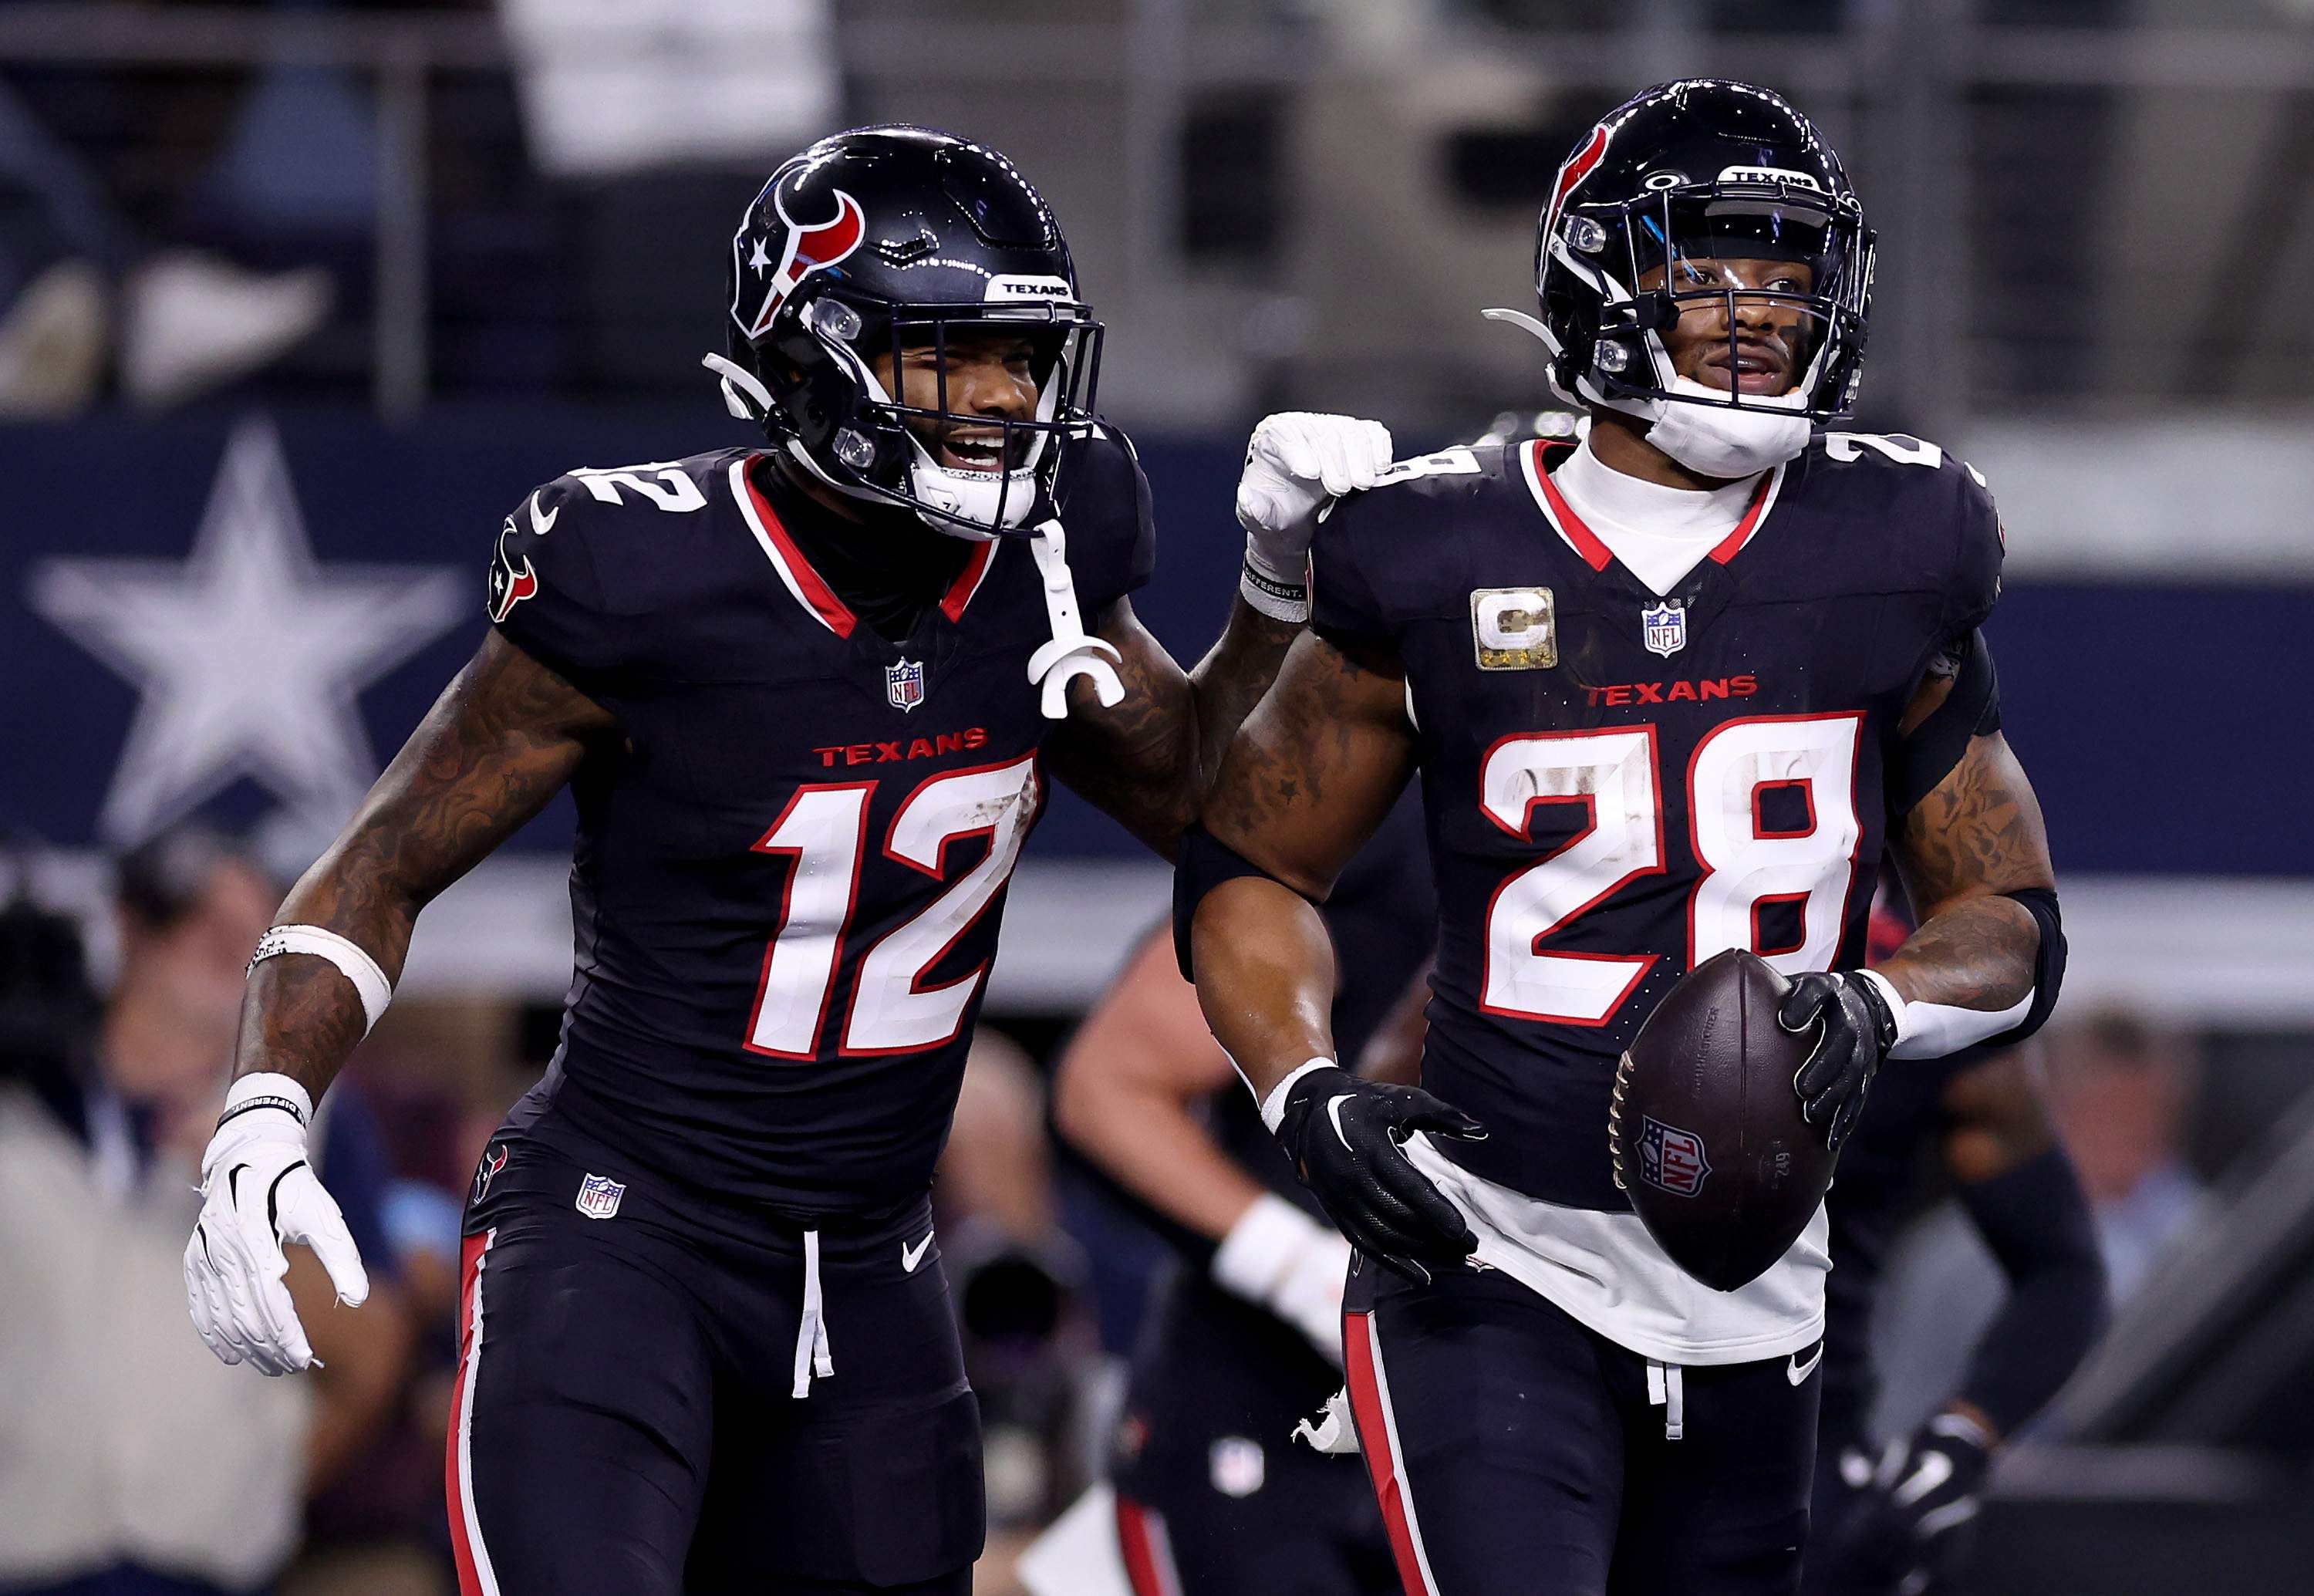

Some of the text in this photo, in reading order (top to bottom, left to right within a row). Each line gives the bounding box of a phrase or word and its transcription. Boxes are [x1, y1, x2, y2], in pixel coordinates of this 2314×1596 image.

[1732, 172, 1813, 187] TEXANS
[1003, 284, 1068, 295] TEXANS
[1477, 593, 1548, 650] C
[1650, 626, 1680, 646] NFL
[893, 682, 919, 703] NFL
[1580, 675, 1758, 707] TEXANS
[812, 727, 988, 767] TEXANS
[1479, 710, 1867, 1027] 28
[742, 747, 1037, 1061] 12
[1663, 1139, 1700, 1190] NFL
[583, 1190, 612, 1212] NFL
